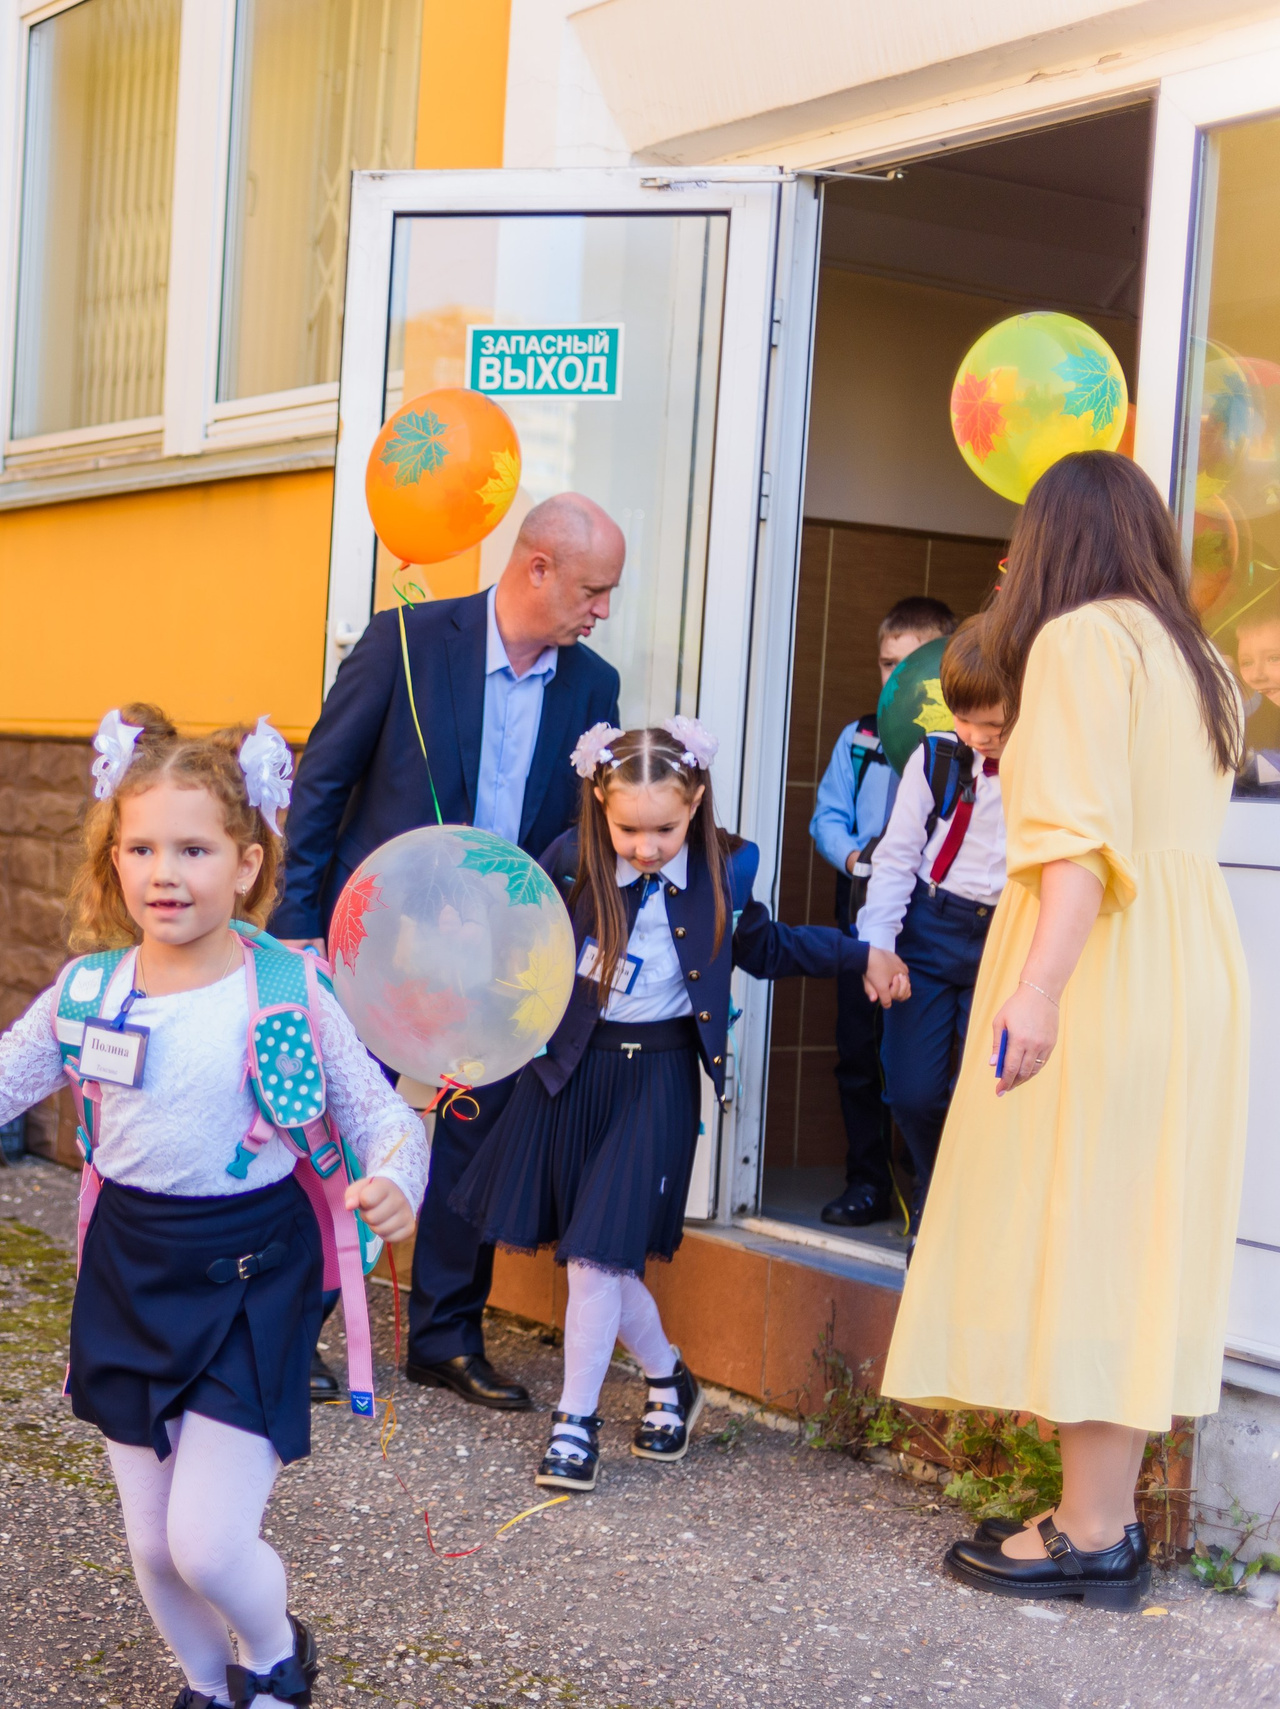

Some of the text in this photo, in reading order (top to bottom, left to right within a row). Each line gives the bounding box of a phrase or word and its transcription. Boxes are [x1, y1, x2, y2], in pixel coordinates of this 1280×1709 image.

[480, 330, 610, 355] ЗАПАСНЫЙ
[478, 355, 608, 392] ВЫХОД
[91, 1037, 130, 1058] Полина
